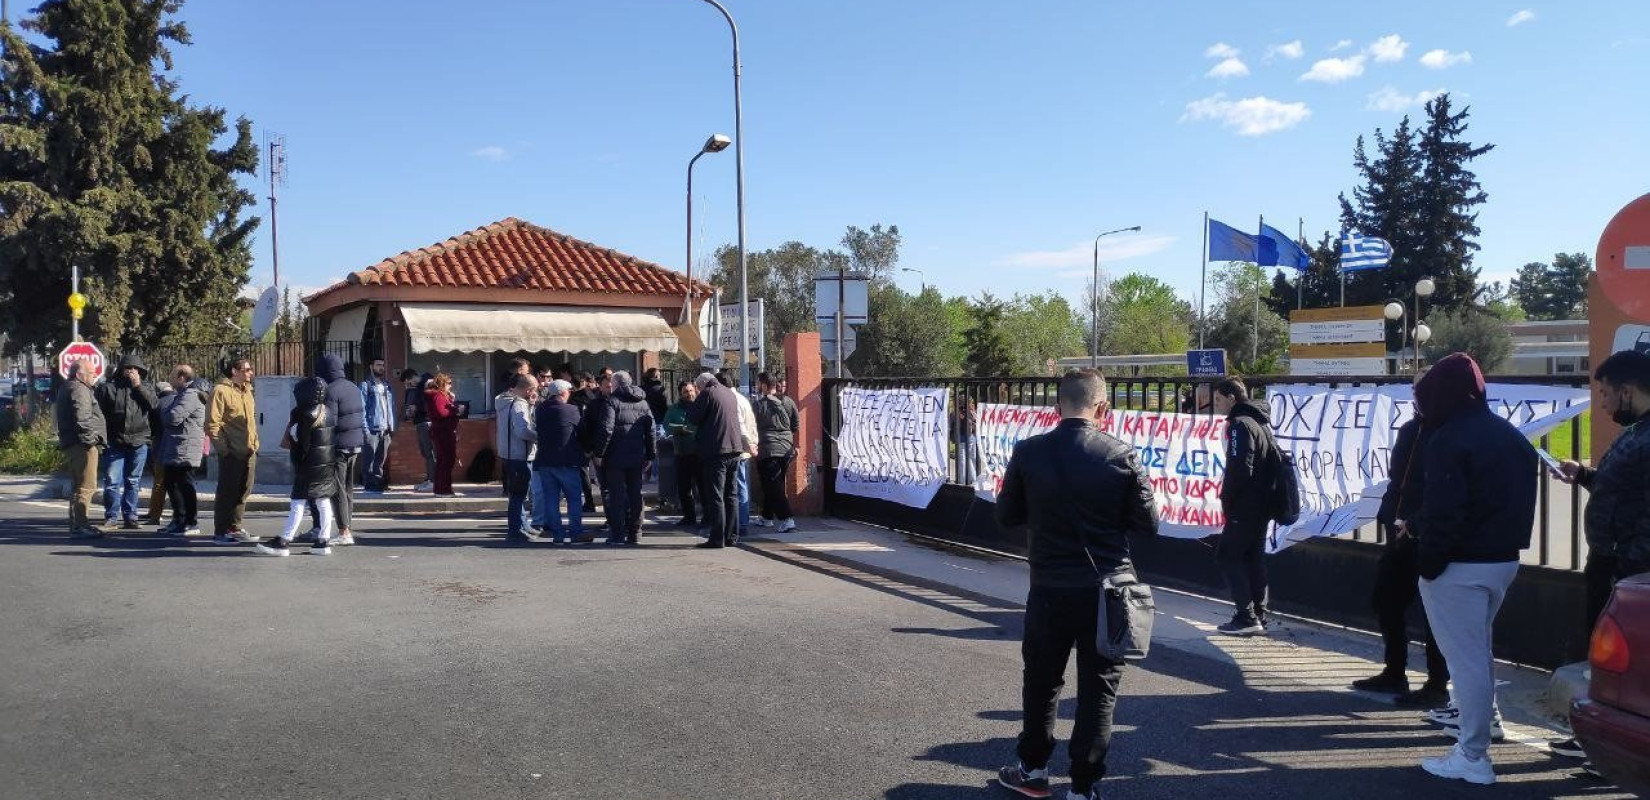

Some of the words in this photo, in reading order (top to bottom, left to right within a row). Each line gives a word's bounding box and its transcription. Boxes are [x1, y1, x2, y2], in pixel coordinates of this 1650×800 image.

[1270, 391, 1328, 434] ΟΧΙ
[1332, 399, 1373, 429] ΣΕ
[1175, 449, 1227, 477] ΔΕΝ
[1356, 447, 1392, 480] ΚΑΤ
[1184, 479, 1224, 500] ΙΔΡΥ
